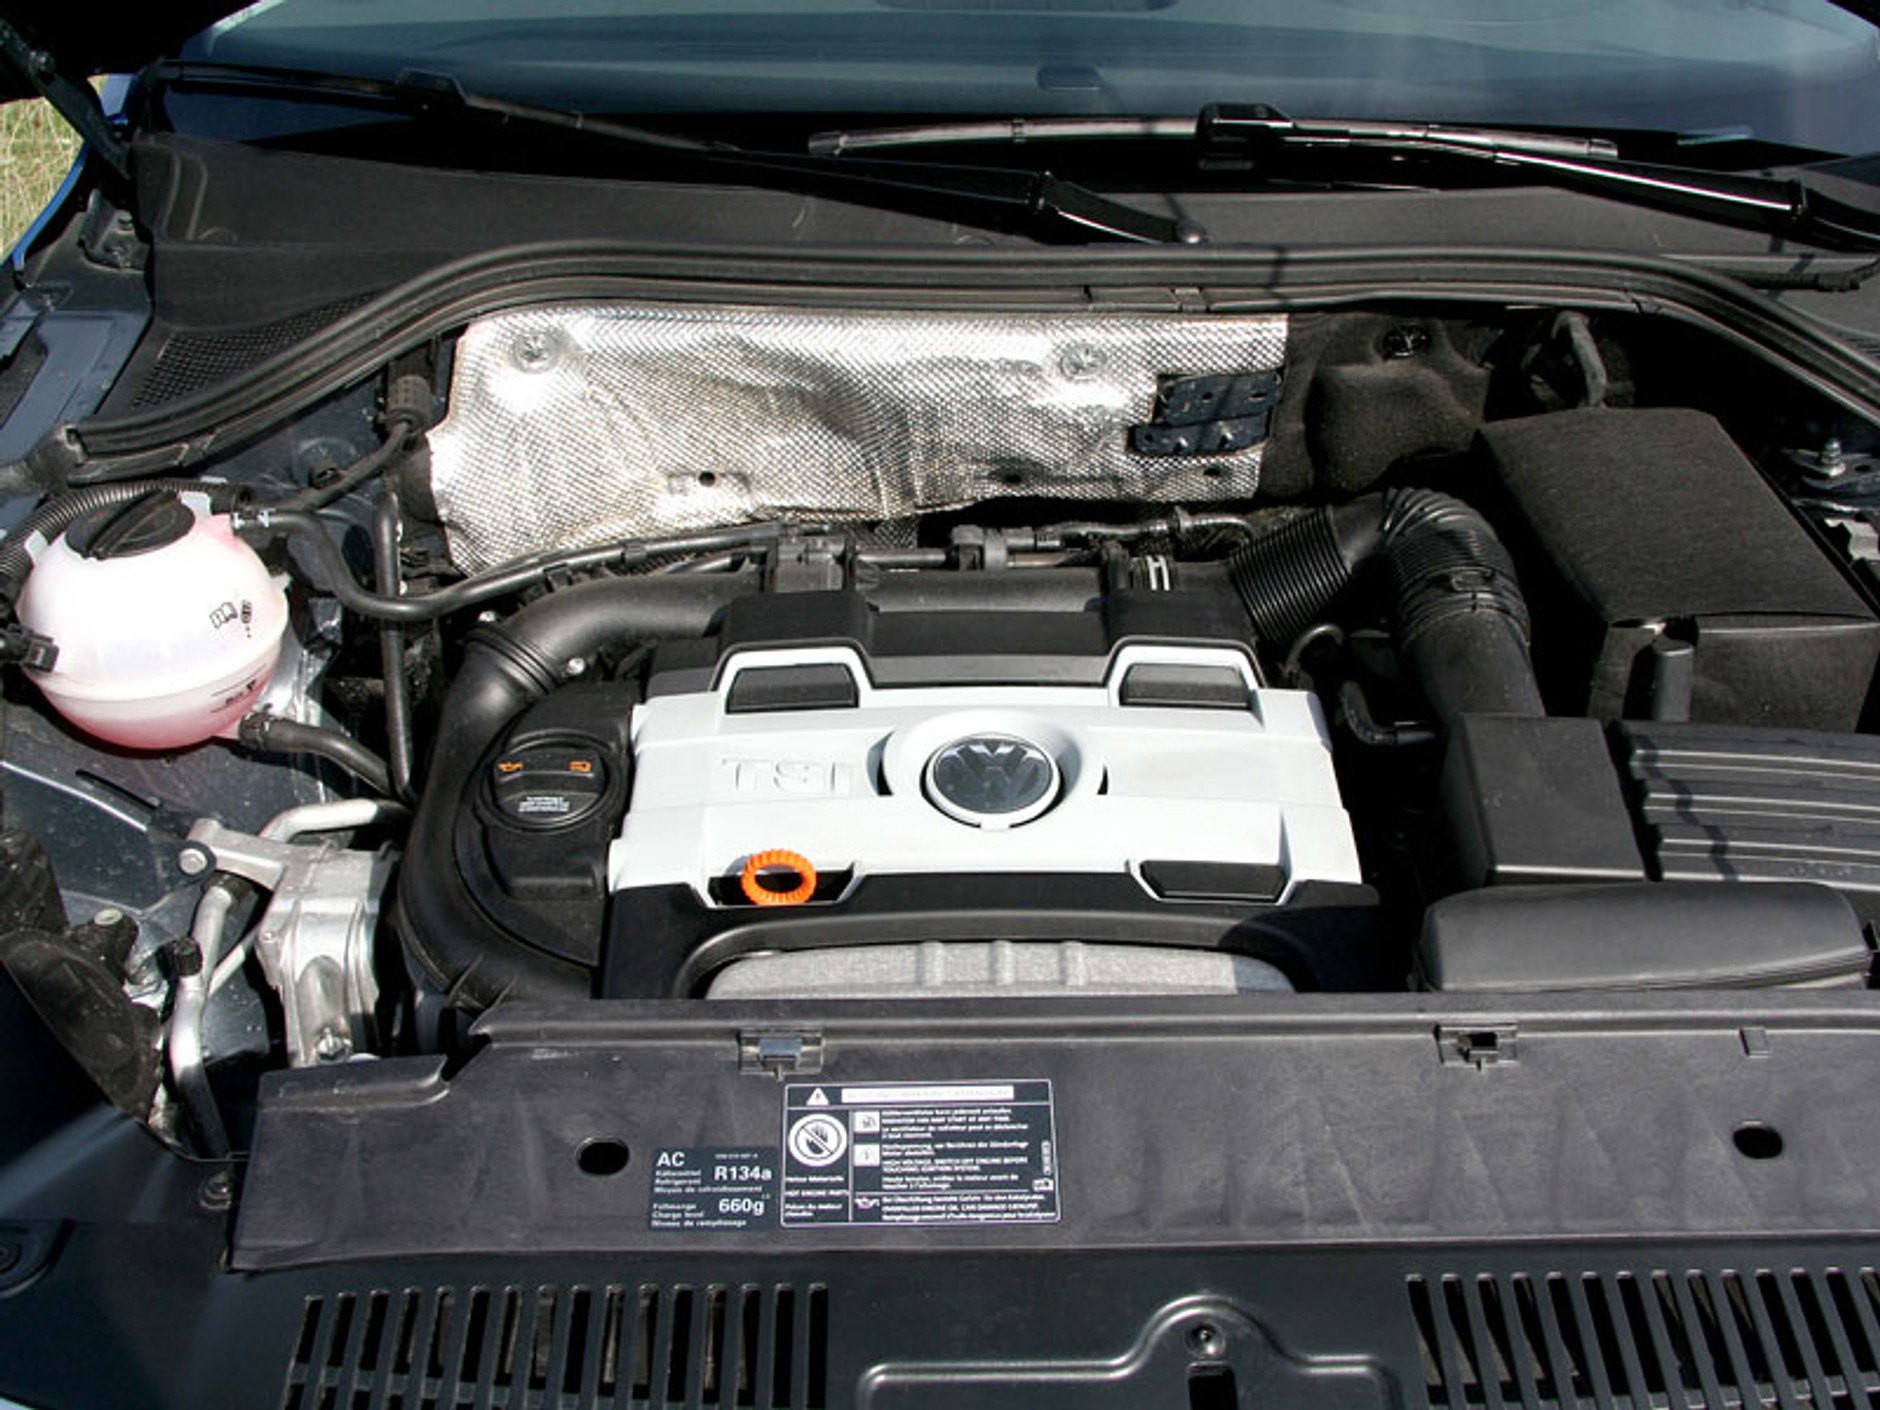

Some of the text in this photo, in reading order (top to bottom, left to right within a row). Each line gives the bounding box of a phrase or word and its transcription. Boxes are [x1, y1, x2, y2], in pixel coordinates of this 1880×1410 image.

[721, 757, 854, 793] TSI
[656, 1151, 686, 1167] AC
[714, 1165, 773, 1181] R134a
[718, 1197, 766, 1217] 660g
